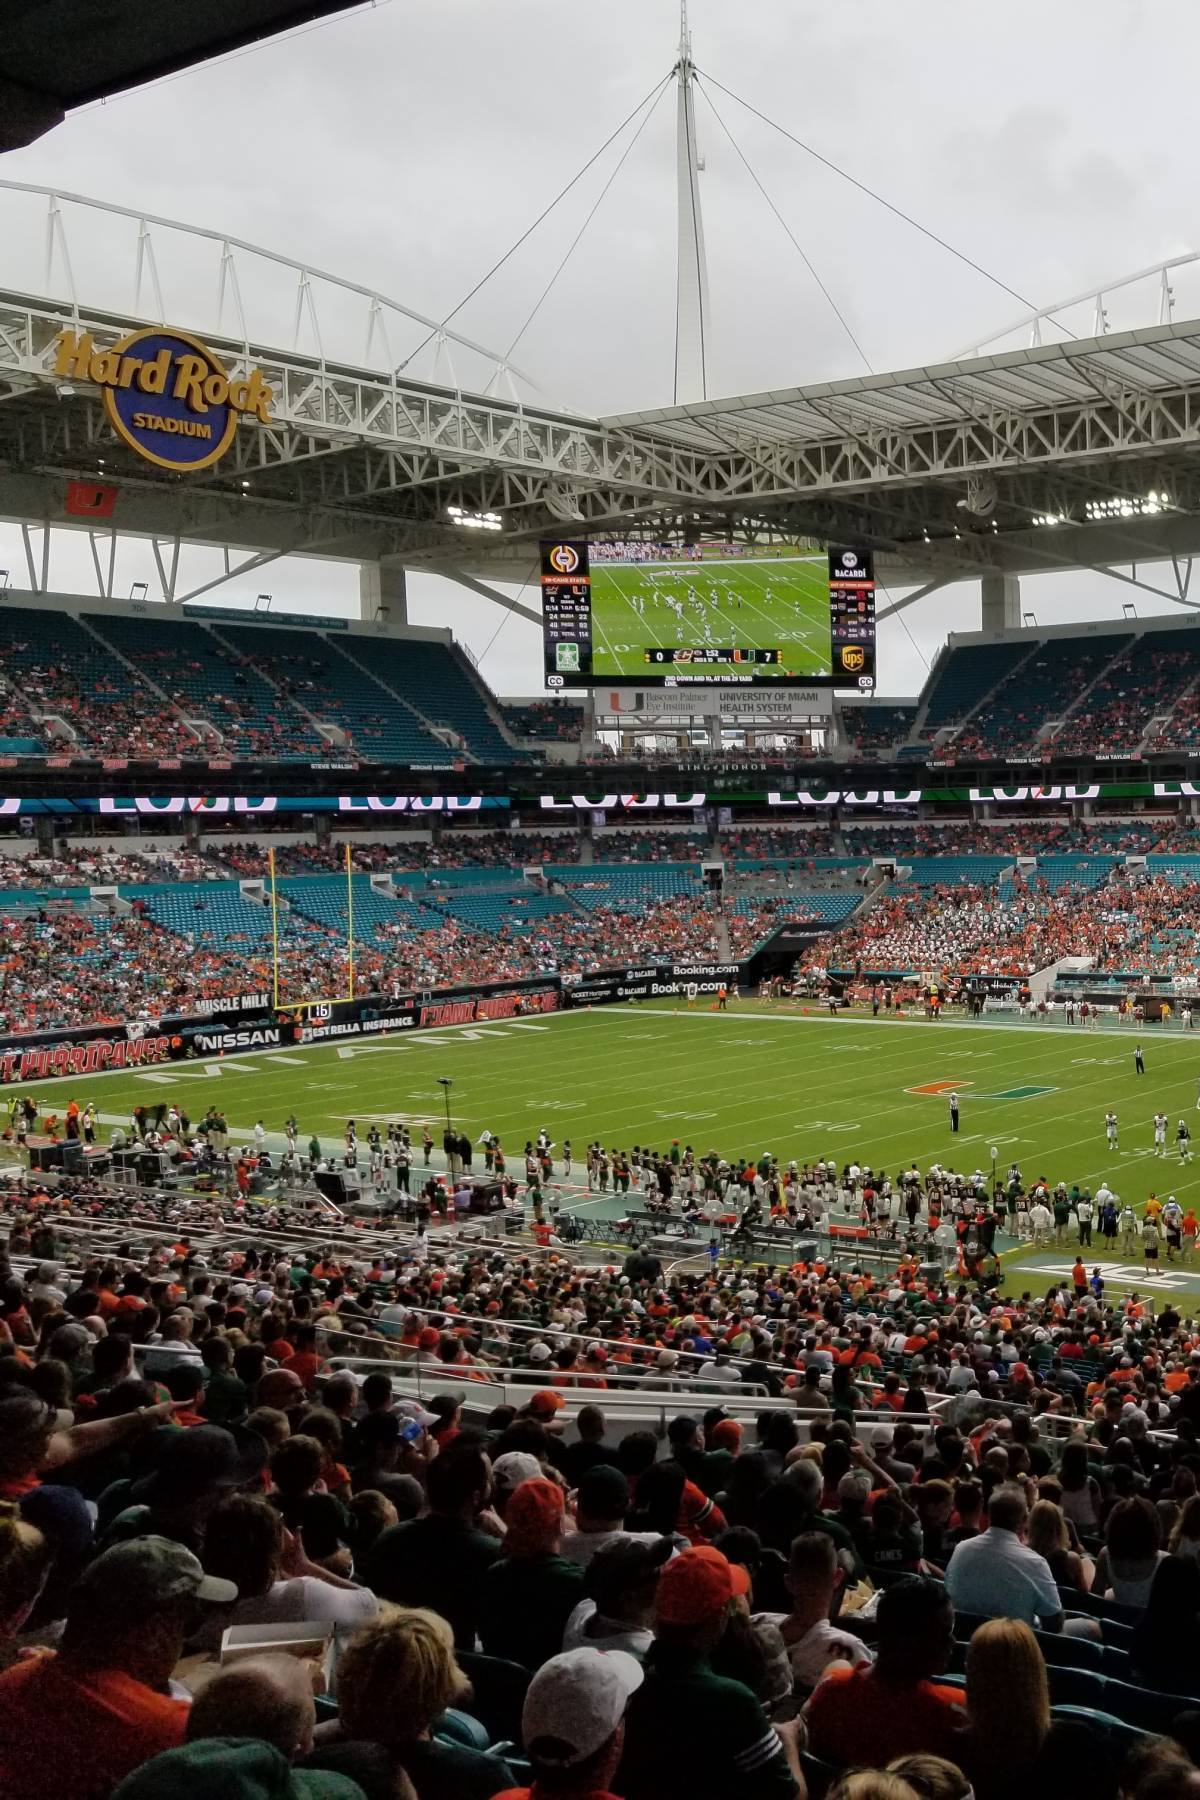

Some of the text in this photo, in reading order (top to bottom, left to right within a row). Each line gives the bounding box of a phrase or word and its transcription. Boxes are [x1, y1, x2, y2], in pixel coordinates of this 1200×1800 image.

[55, 330, 273, 424] Hard Rock
[132, 412, 212, 440] STADIUM
[656, 652, 663, 661] 0
[765, 652, 771, 662] 7
[844, 654, 862, 668] ups
[549, 677, 562, 685] CC
[860, 678, 872, 686] CC
[646, 692, 708, 701] Bascom Palmer
[720, 693, 818, 701] UNIVERSITY OF MIAMI
[646, 703, 696, 712] Eye Institute
[720, 704, 792, 712] HEALTH SYSTEM
[721, 763, 767, 774] HONOR
[673, 965, 739, 976] Booking.com
[195, 994, 269, 1013] MUSCLE MILK
[315, 1002, 328, 1017] 16
[202, 1029, 280, 1050] NISSAN
[21, 1037, 171, 1080] HURRICANES
